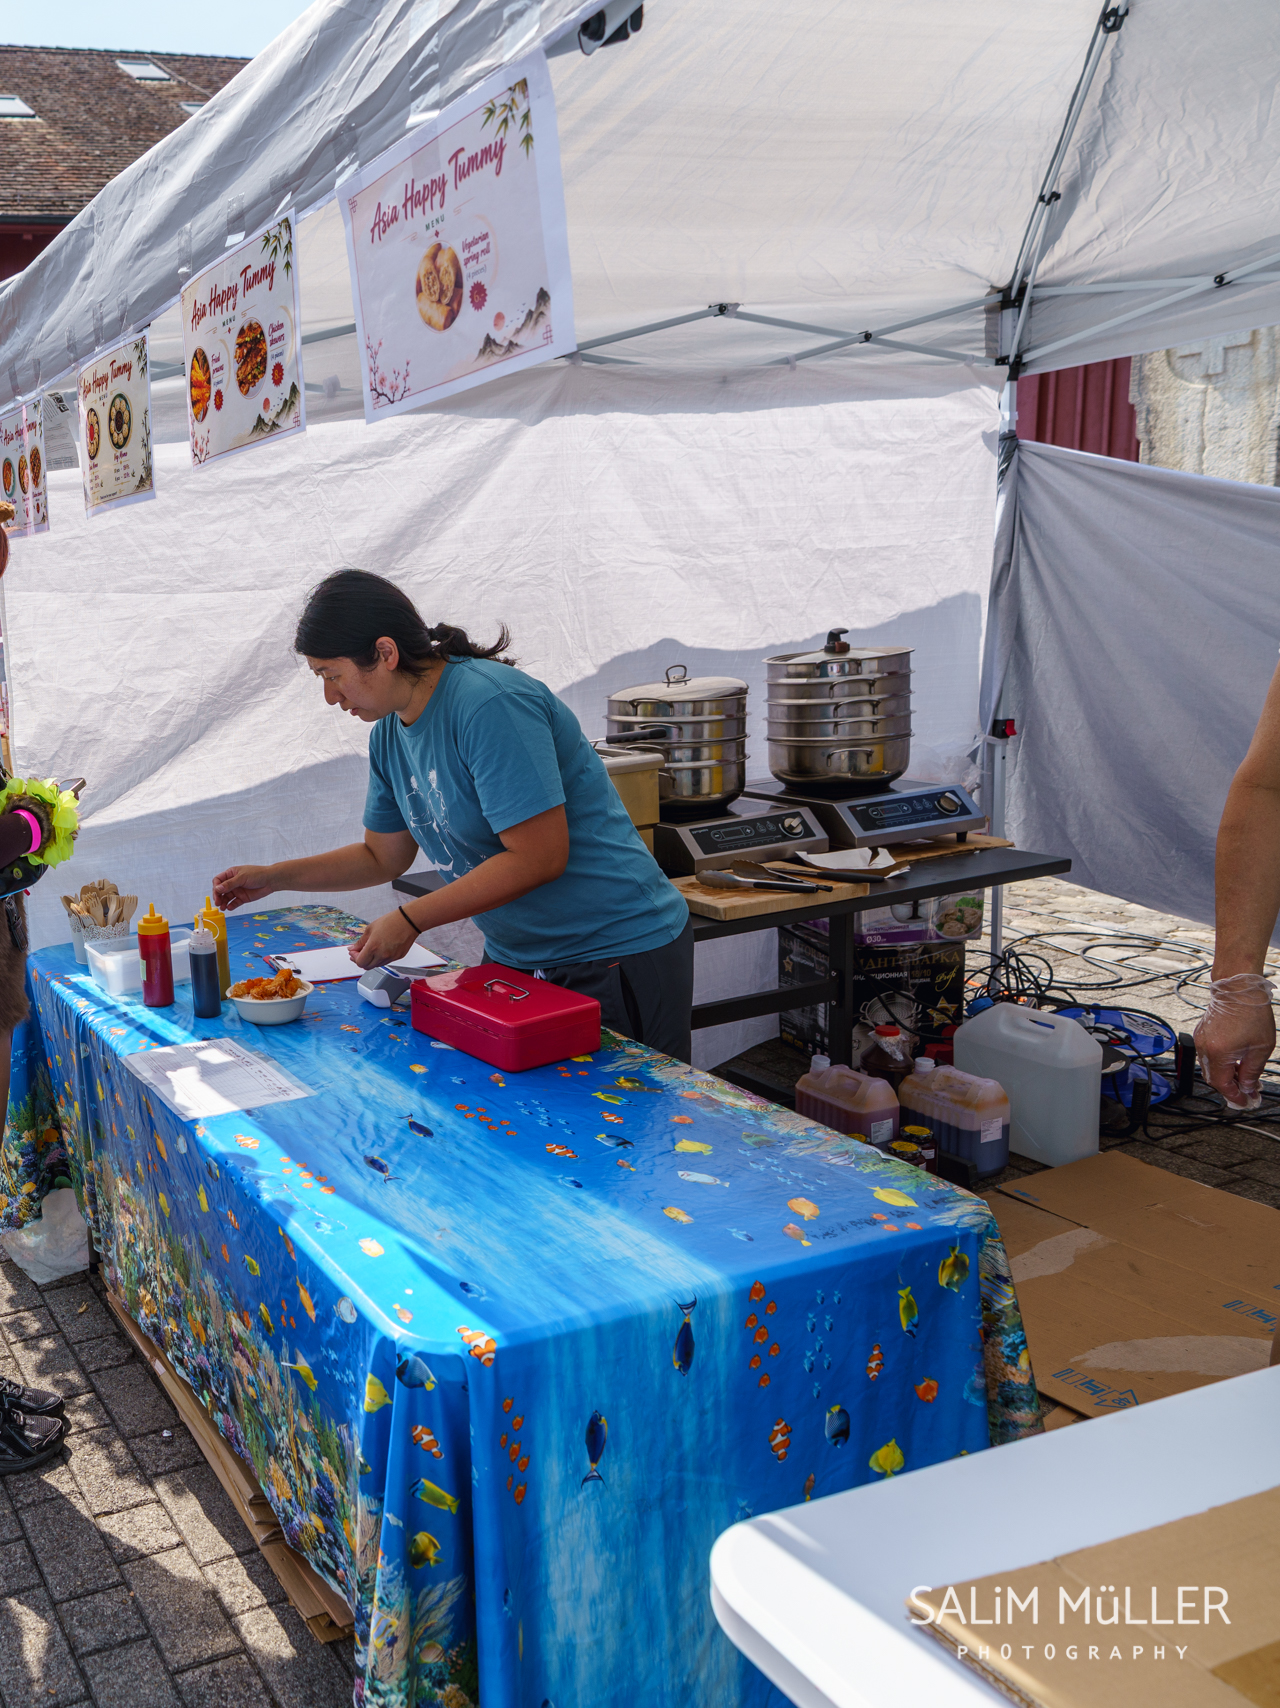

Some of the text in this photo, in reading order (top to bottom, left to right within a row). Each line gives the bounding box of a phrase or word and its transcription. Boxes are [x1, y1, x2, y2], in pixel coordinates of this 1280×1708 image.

[370, 137, 507, 244] Asia Happy Tummy
[425, 214, 445, 232] MENU
[462, 232, 489, 254] Vegetarian
[463, 241, 491, 269] spring roll
[191, 261, 276, 332] Asia Happy Tummy
[83, 359, 132, 401] Asia Happy Tummy
